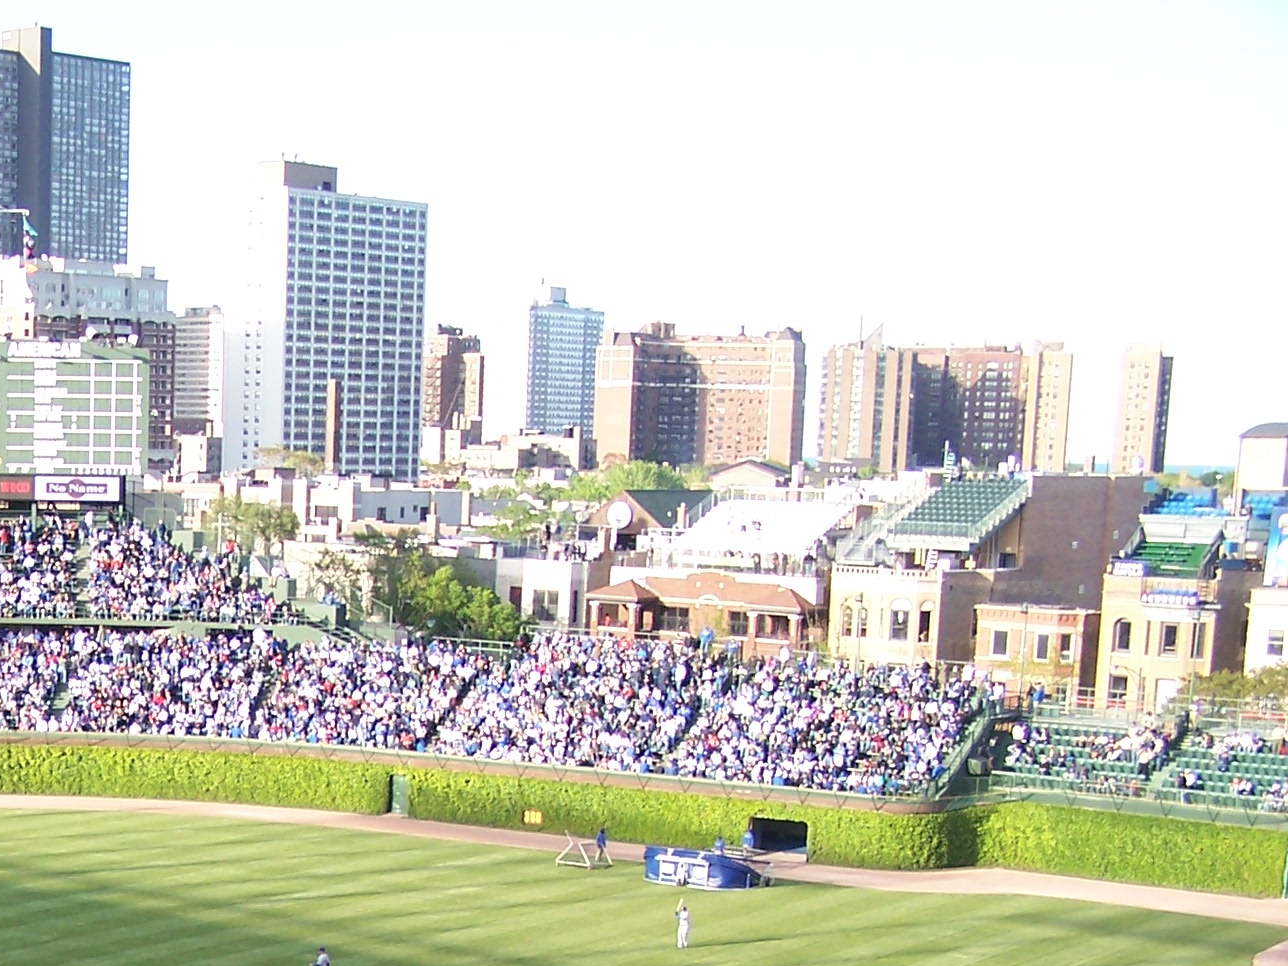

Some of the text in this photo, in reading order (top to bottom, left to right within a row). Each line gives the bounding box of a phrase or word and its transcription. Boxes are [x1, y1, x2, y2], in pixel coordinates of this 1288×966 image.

[8, 342, 81, 357] AMERICAN
[0, 481, 30, 493] WOOD
[49, 483, 106, 493] No Name
